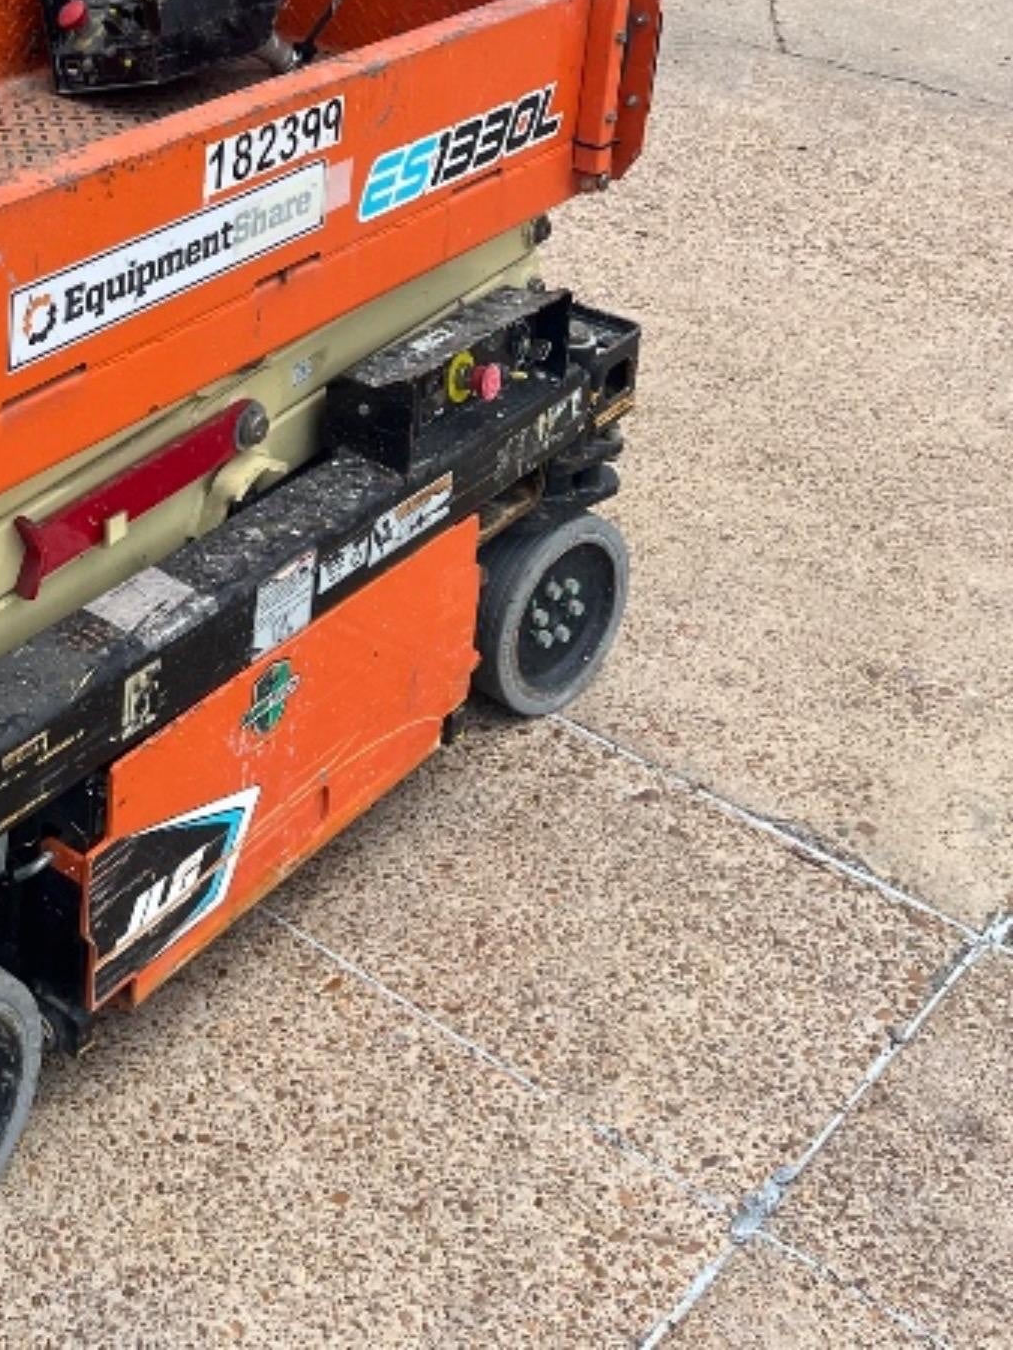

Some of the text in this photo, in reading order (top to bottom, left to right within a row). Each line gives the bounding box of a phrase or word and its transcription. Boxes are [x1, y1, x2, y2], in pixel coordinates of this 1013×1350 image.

[209, 97, 342, 190] 182399
[360, 86, 560, 218] ES1330L
[63, 190, 313, 324] EquipmentShare
[116, 844, 208, 948] JLG
